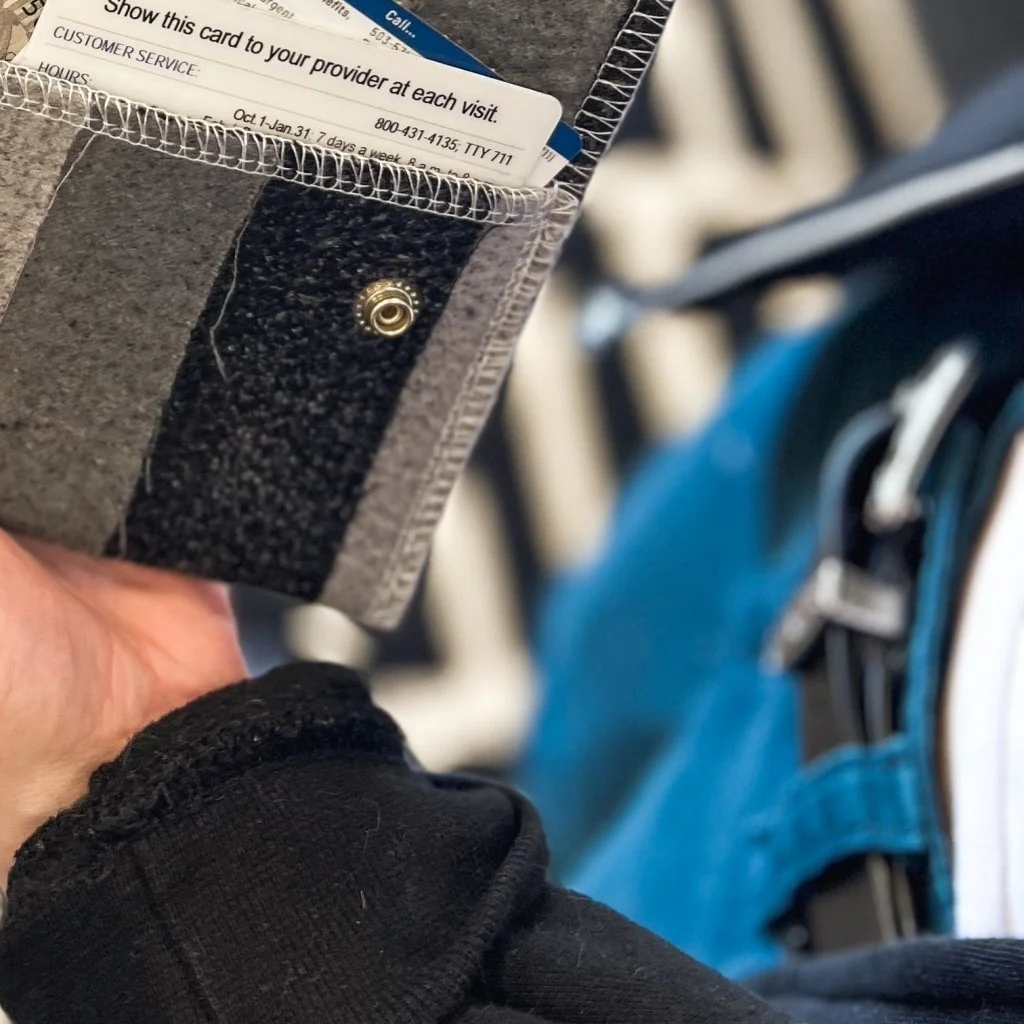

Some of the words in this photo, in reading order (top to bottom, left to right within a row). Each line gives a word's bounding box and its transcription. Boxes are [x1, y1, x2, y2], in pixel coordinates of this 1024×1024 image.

[53, 25, 135, 60] CUSTOMER
[135, 49, 201, 78] SERVICE:
[463, 141, 492, 159] TTY
[491, 150, 513, 166] 711
[162, 11, 196, 36] this
[199, 25, 244, 49] card
[244, 35, 264, 55] to
[264, 44, 311, 68] your
[309, 57, 389, 91] provider
[389, 79, 411, 98] at
[411, 87, 458, 111] each
[461, 99, 498, 124] visit.
[315, 131, 326, 143] 7
[326, 133, 357, 153] days
[357, 145, 367, 156] a
